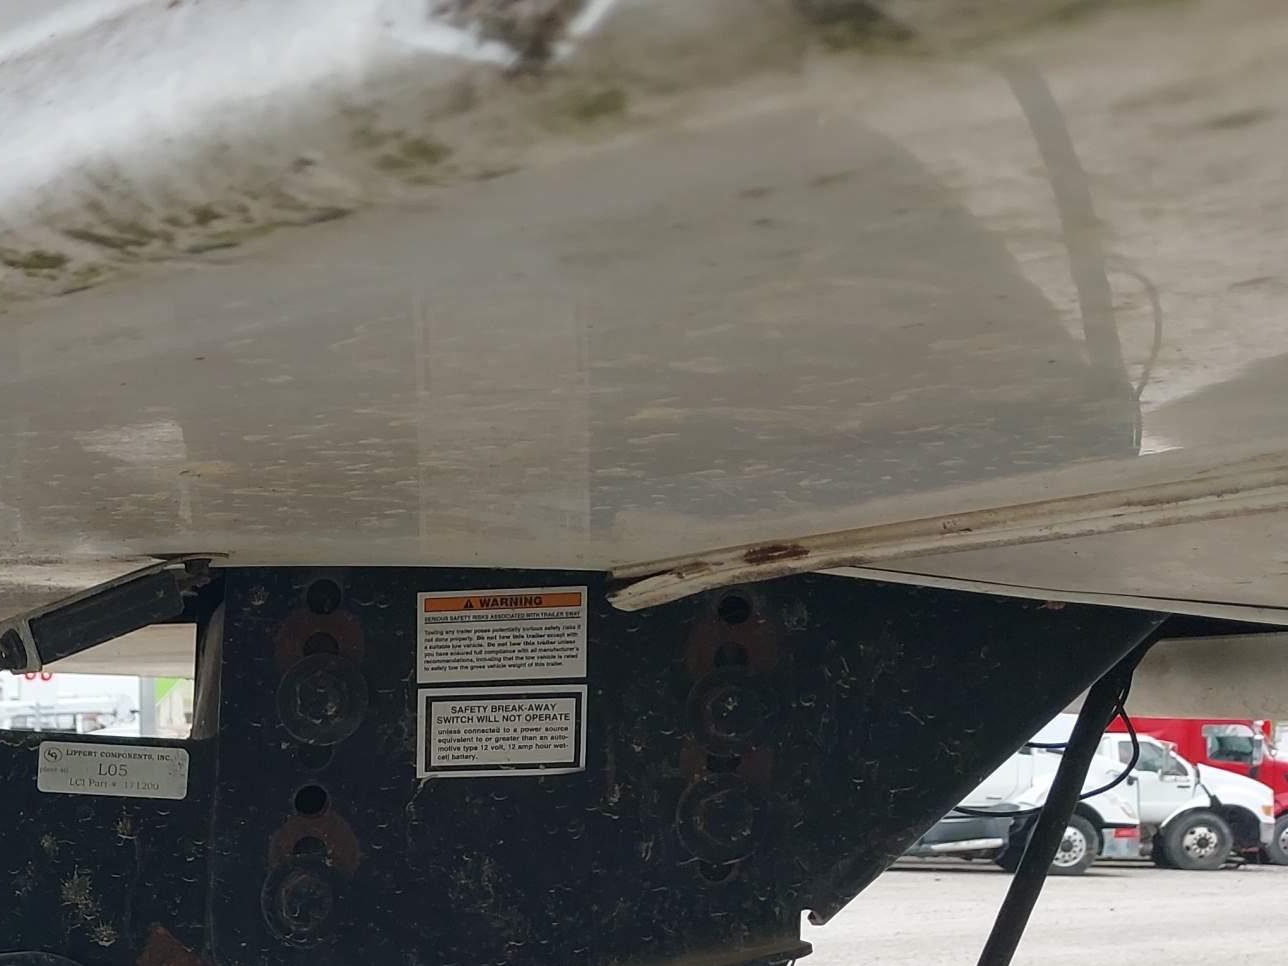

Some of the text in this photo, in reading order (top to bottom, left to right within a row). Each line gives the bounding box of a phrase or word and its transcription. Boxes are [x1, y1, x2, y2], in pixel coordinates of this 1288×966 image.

[479, 596, 543, 609] WARNING
[451, 703, 557, 714] SAFETY BREAK-AWAY
[437, 713, 571, 724] SWITCH WILL NOT OPERATE
[438, 736, 474, 744] equivalent
[99, 763, 128, 777] L05
